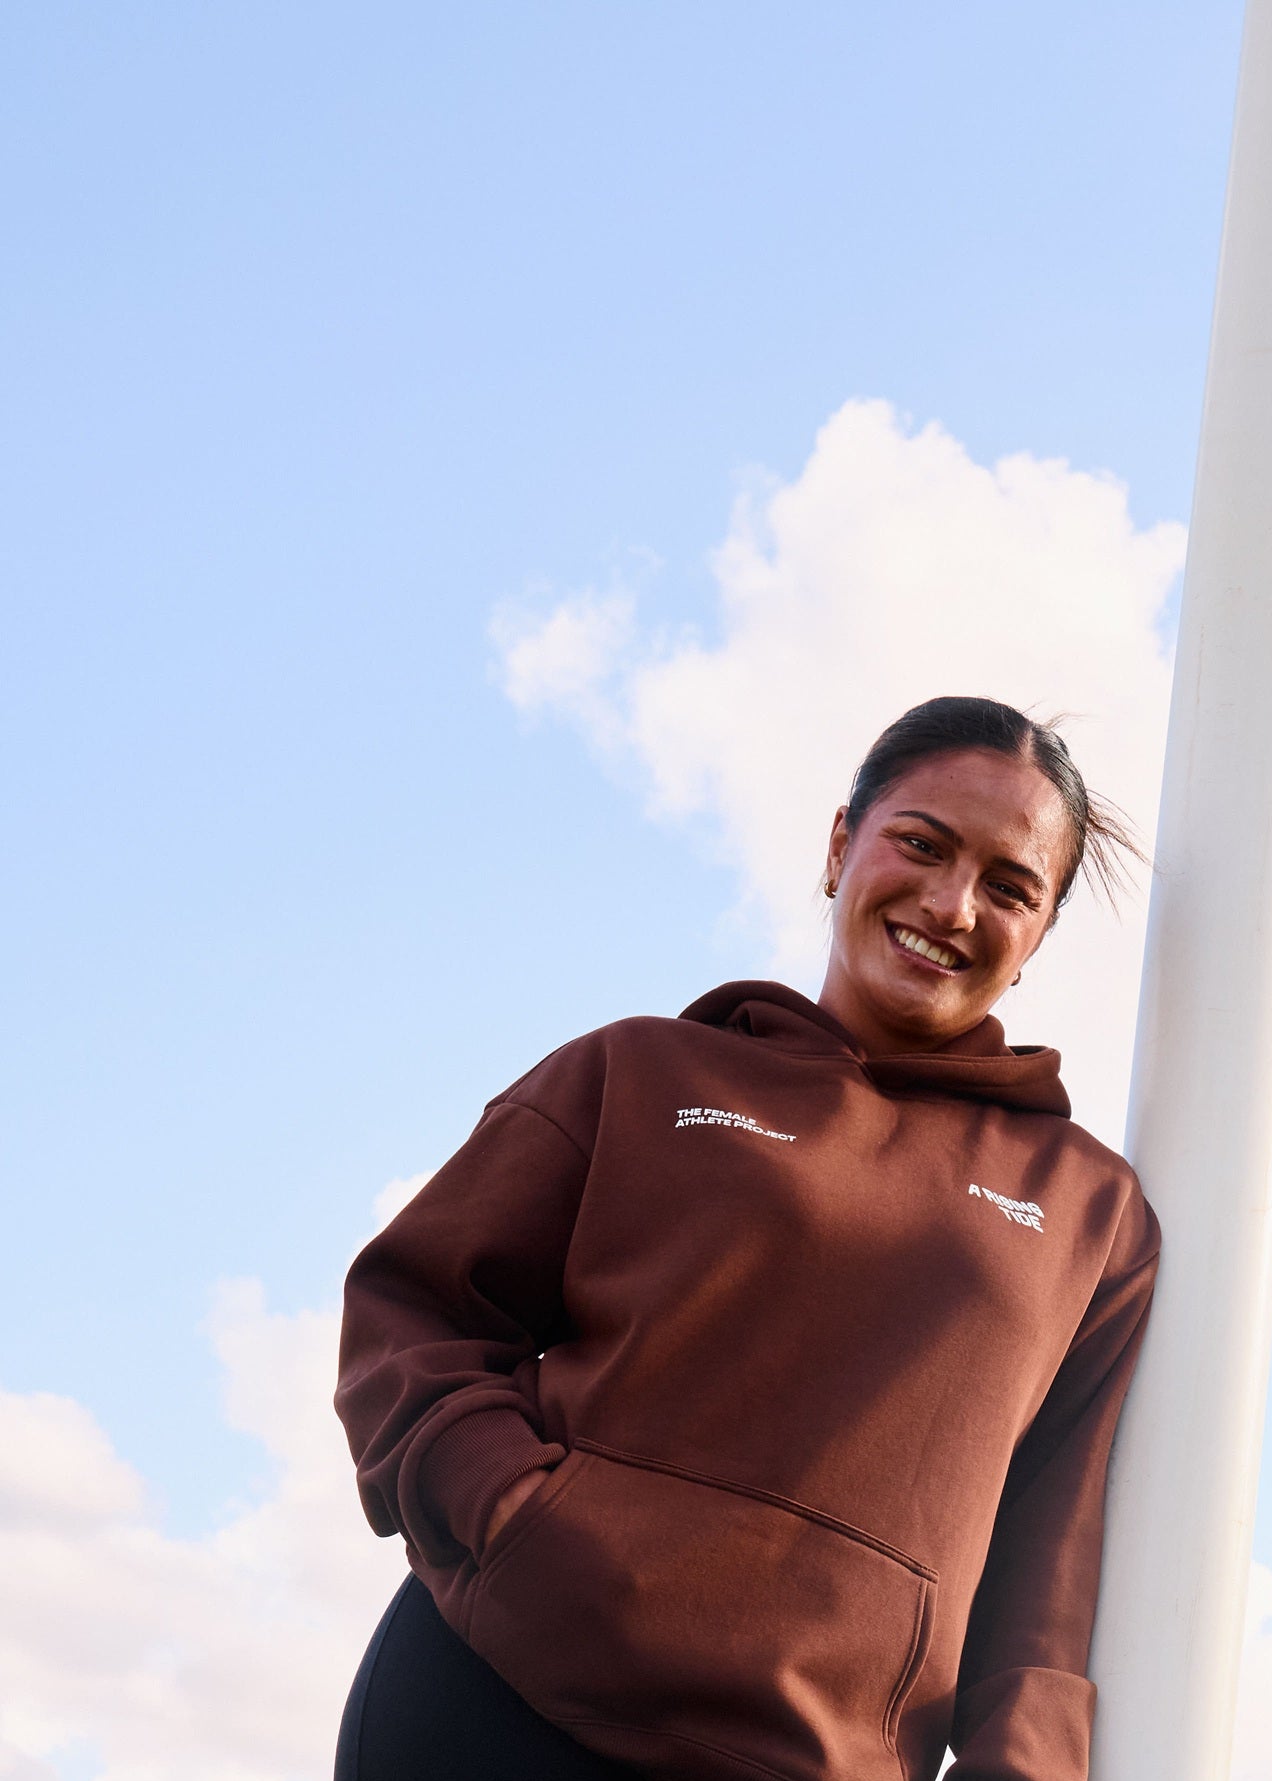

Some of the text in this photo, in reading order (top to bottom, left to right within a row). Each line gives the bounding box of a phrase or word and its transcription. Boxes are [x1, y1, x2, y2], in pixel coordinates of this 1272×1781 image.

[675, 1117, 797, 1142] ATHLETE PROJECT
[677, 1108, 757, 1126] THE FEMALE
[968, 1184, 1045, 1219] A RISING
[998, 1206, 1044, 1233] TIDE
